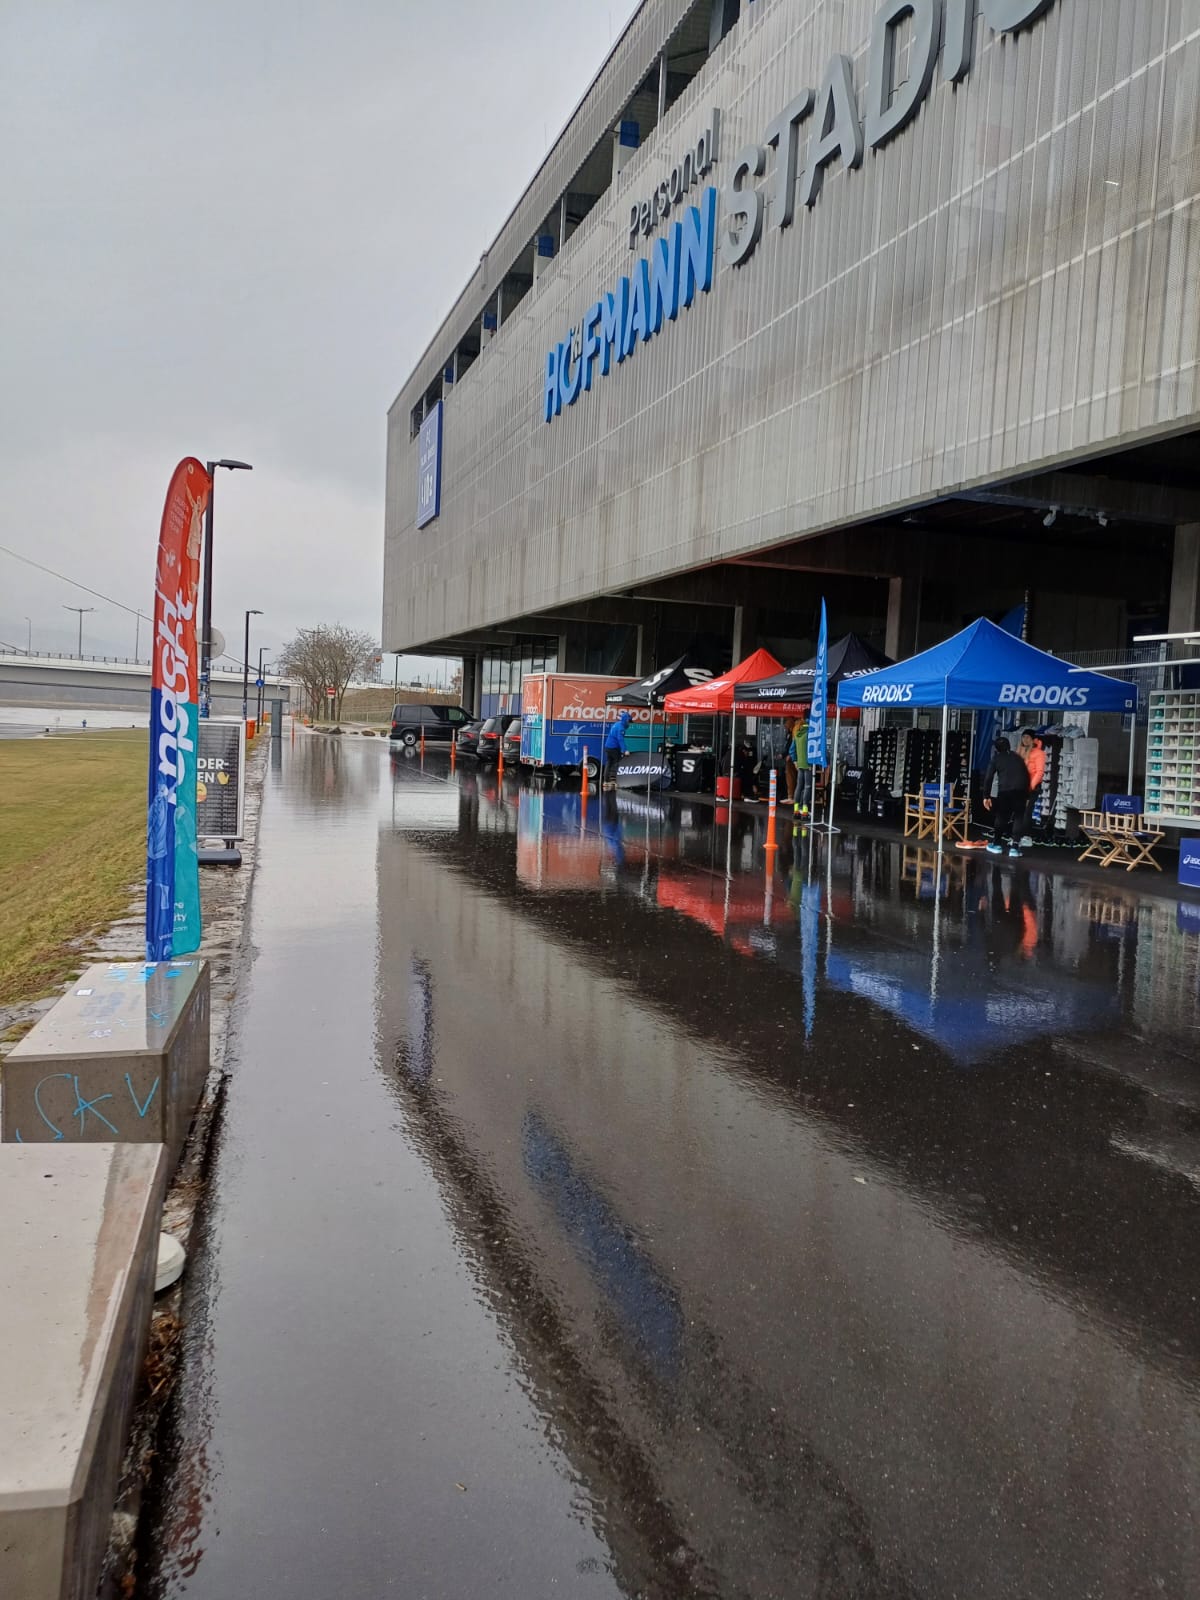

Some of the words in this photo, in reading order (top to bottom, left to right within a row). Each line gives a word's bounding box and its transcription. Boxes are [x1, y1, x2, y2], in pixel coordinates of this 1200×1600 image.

[543, 186, 716, 424] HOFMANN
[719, 0, 1058, 267] STADI
[862, 684, 914, 703] BROOKS
[999, 684, 1090, 706] BROOKS
[616, 765, 667, 776] SALOMON
